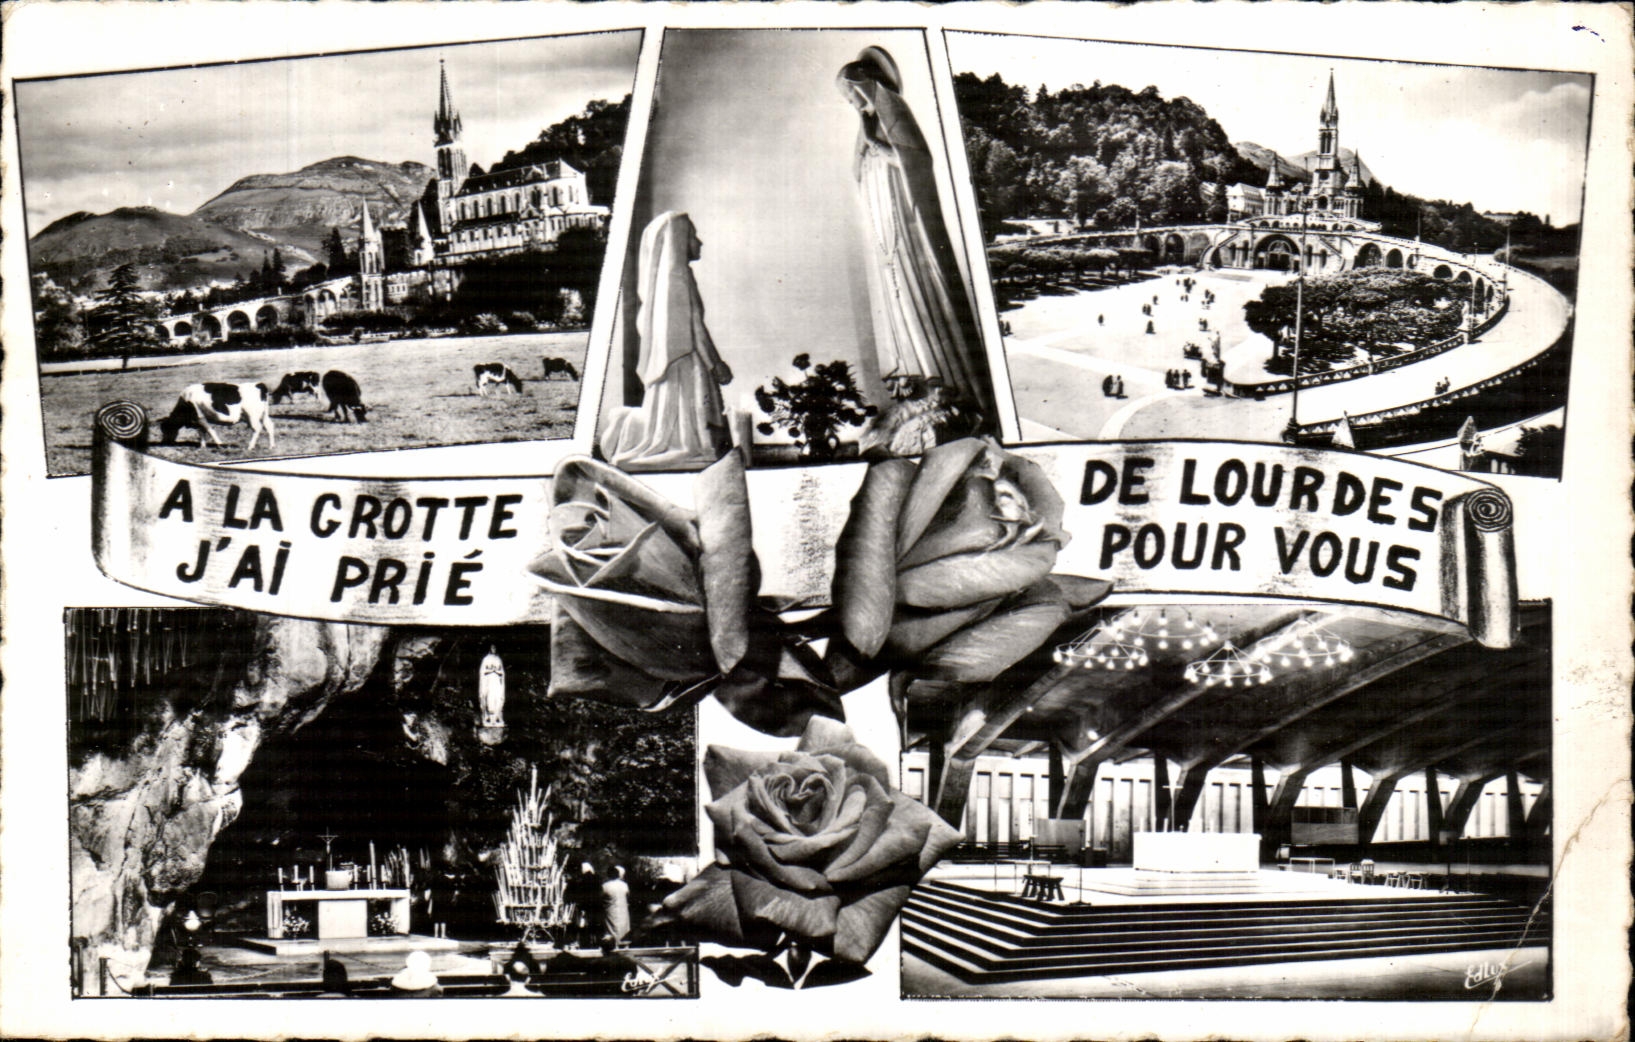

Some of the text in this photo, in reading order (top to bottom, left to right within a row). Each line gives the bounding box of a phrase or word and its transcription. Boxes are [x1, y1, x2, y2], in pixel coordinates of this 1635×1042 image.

[159, 457, 1443, 541] A LA GROTTE DE LOURDES
[1100, 522, 1246, 571] POUR
[1274, 526, 1420, 592] VOUS
